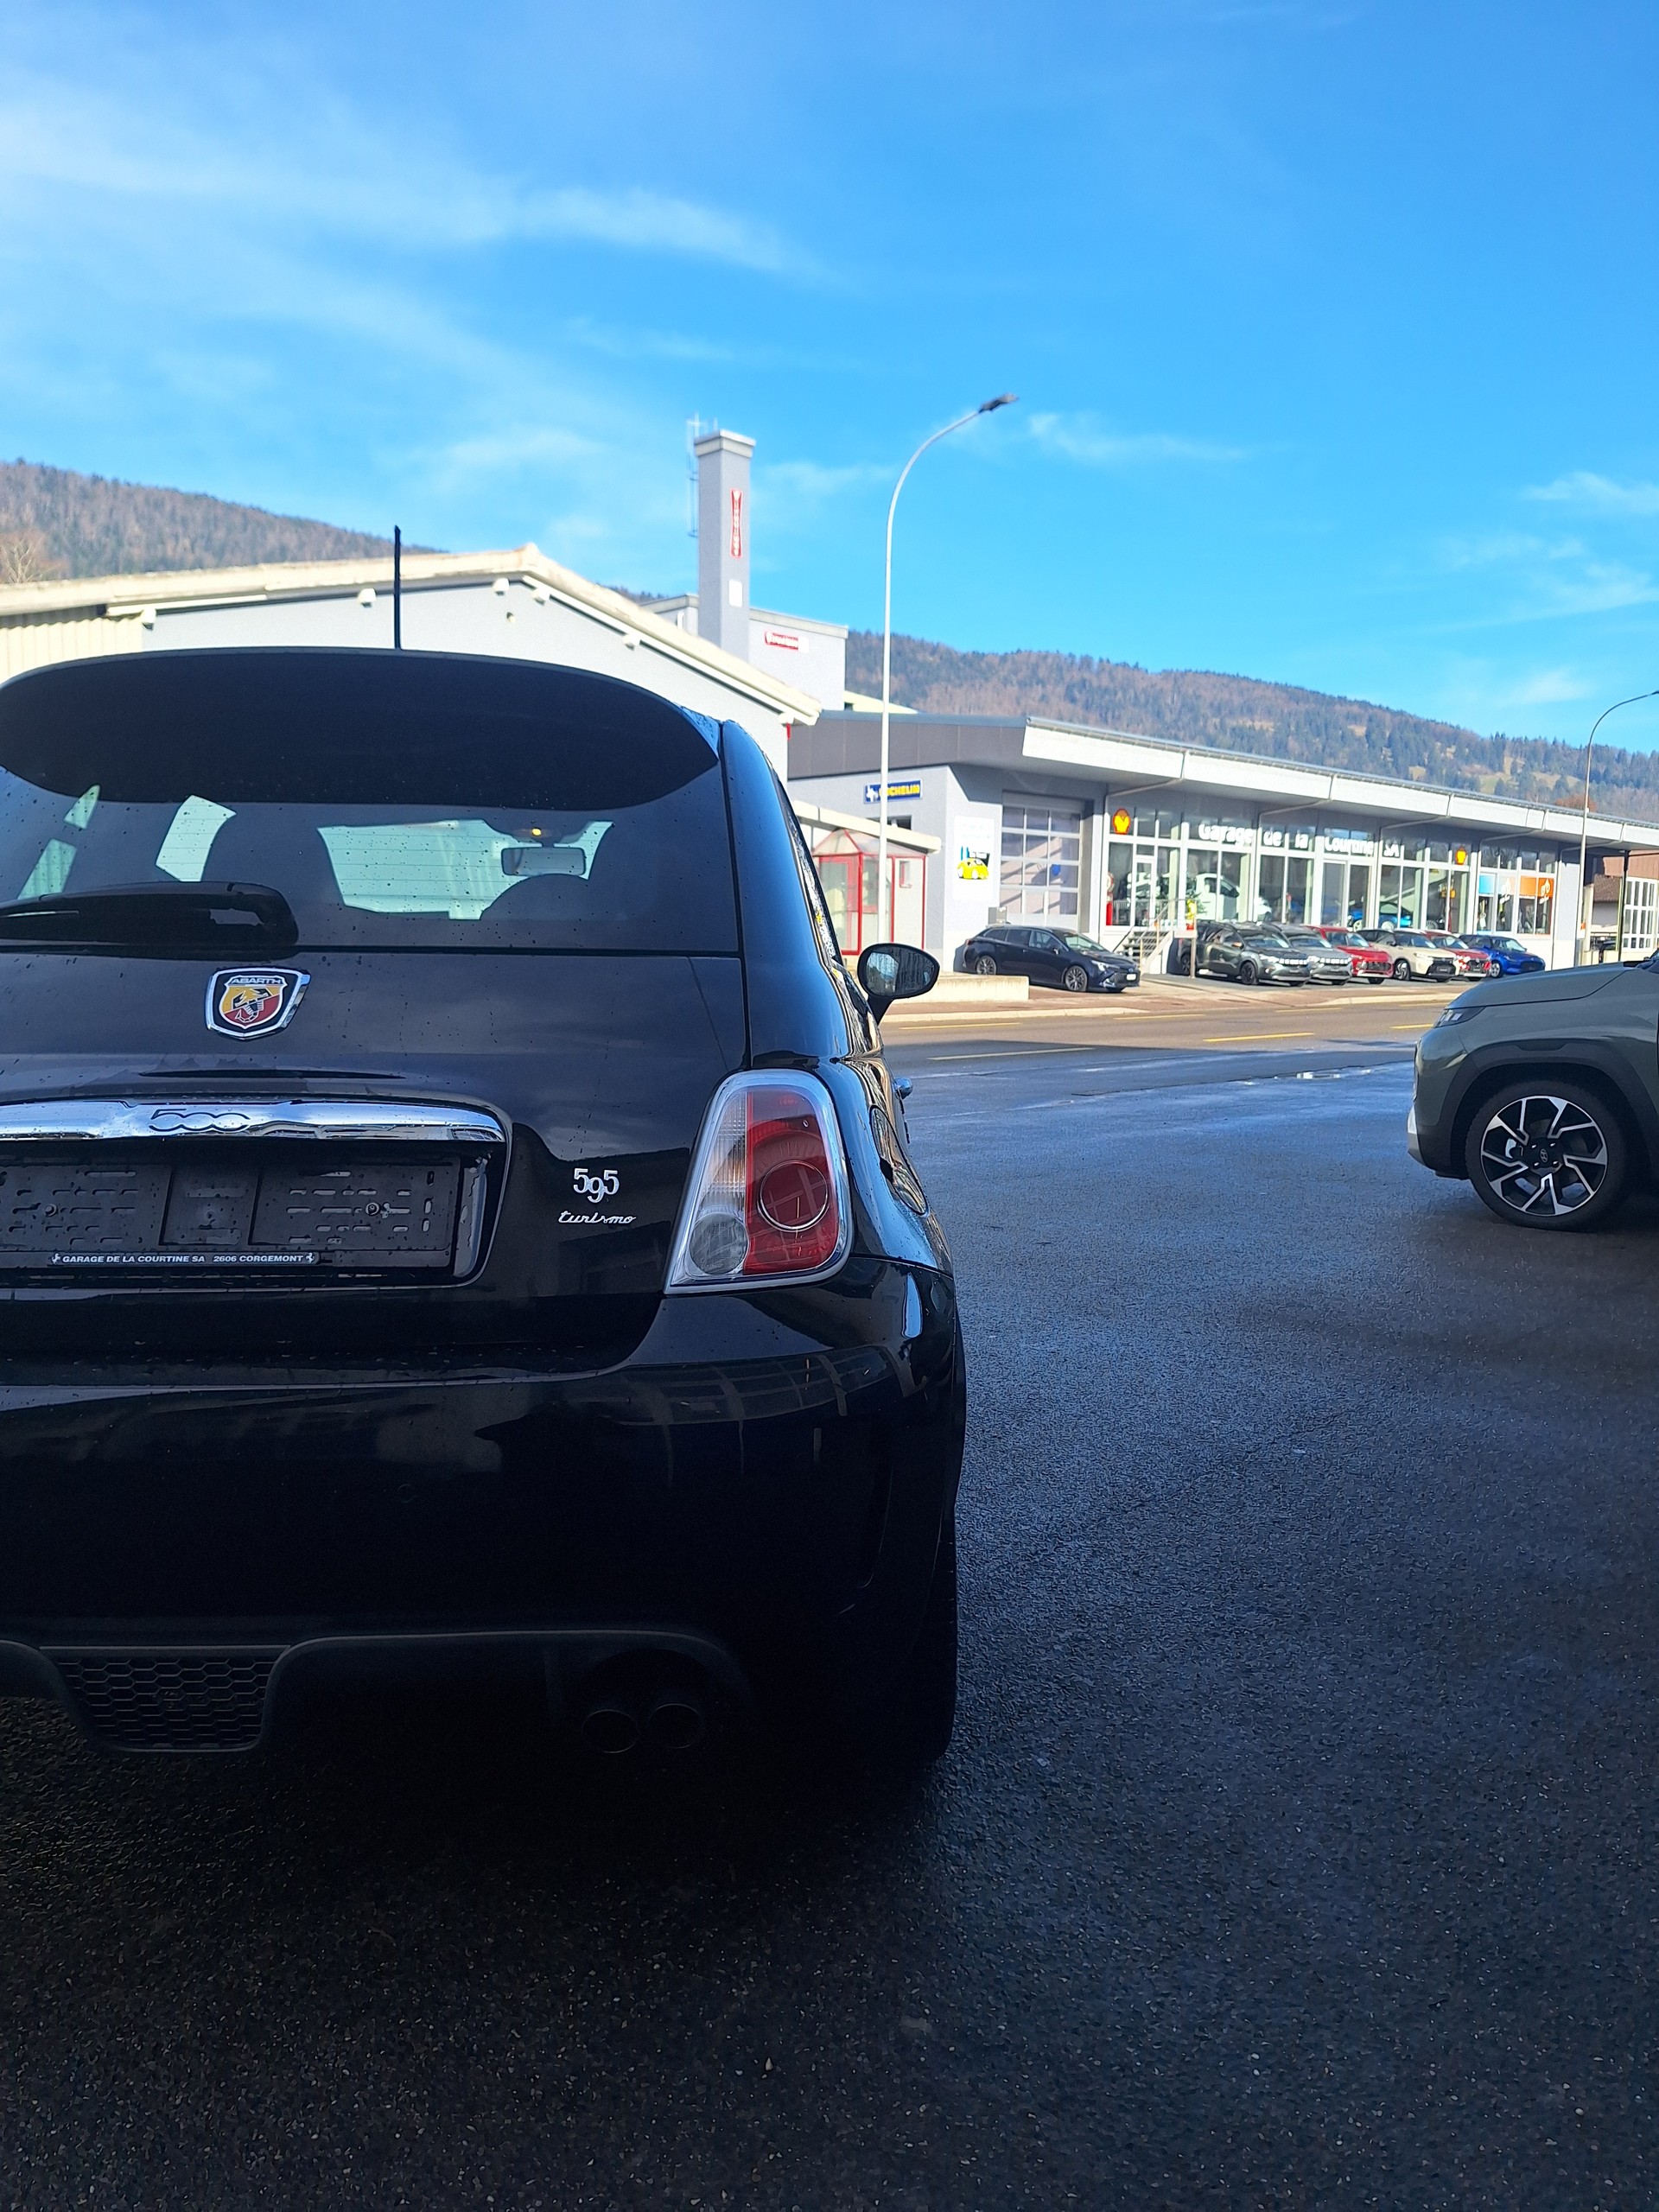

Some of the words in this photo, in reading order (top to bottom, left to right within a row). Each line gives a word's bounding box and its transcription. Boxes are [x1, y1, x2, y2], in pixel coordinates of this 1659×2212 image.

[1198, 822, 1253, 849] Garage
[1263, 827, 1282, 846] de
[1295, 830, 1309, 849] la
[1383, 839, 1399, 857] SA
[149, 1109, 251, 1132] 500
[573, 1168, 620, 1203] 595
[558, 1211, 637, 1224] turismo
